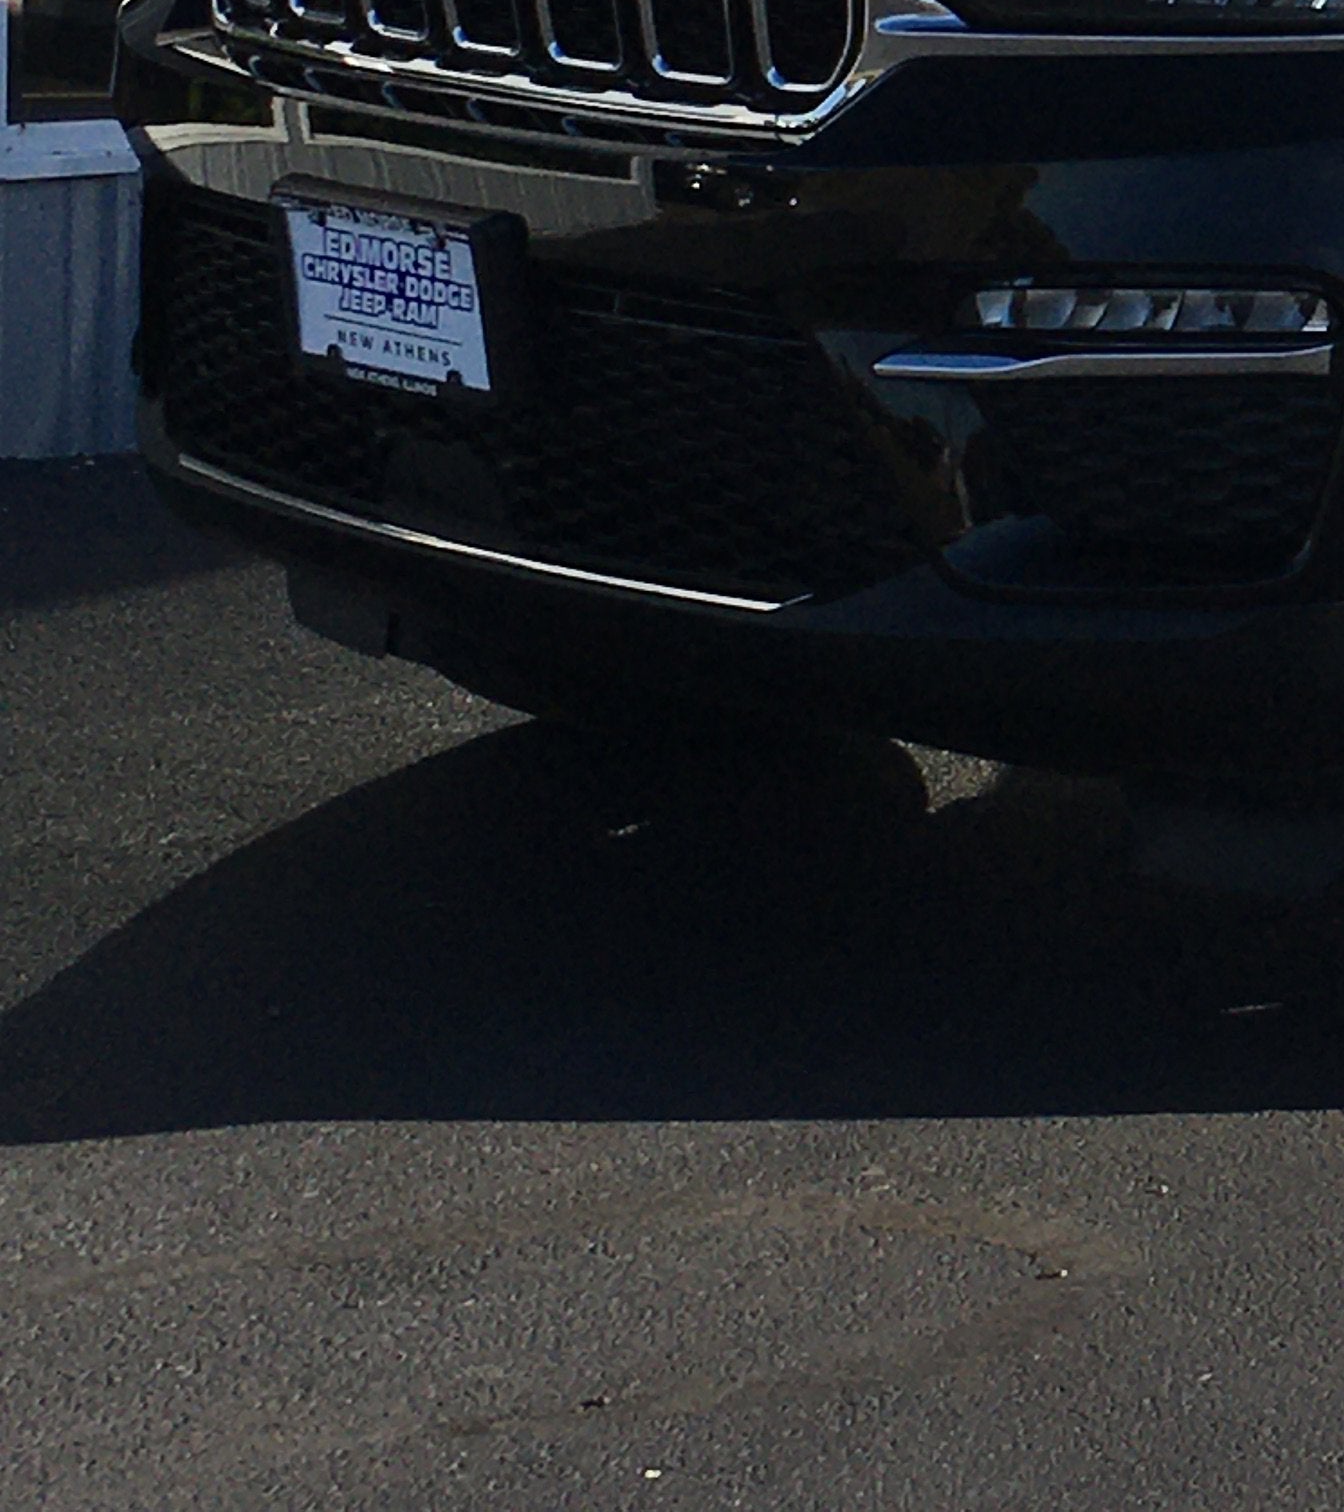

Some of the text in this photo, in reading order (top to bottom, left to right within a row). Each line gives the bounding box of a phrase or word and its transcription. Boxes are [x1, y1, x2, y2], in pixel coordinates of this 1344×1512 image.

[325, 228, 451, 279] ED MORSE
[302, 254, 473, 310] CHRYSLER DODGE
[340, 287, 439, 328] JEEP RAM
[337, 329, 451, 367] NEW ATHENS
